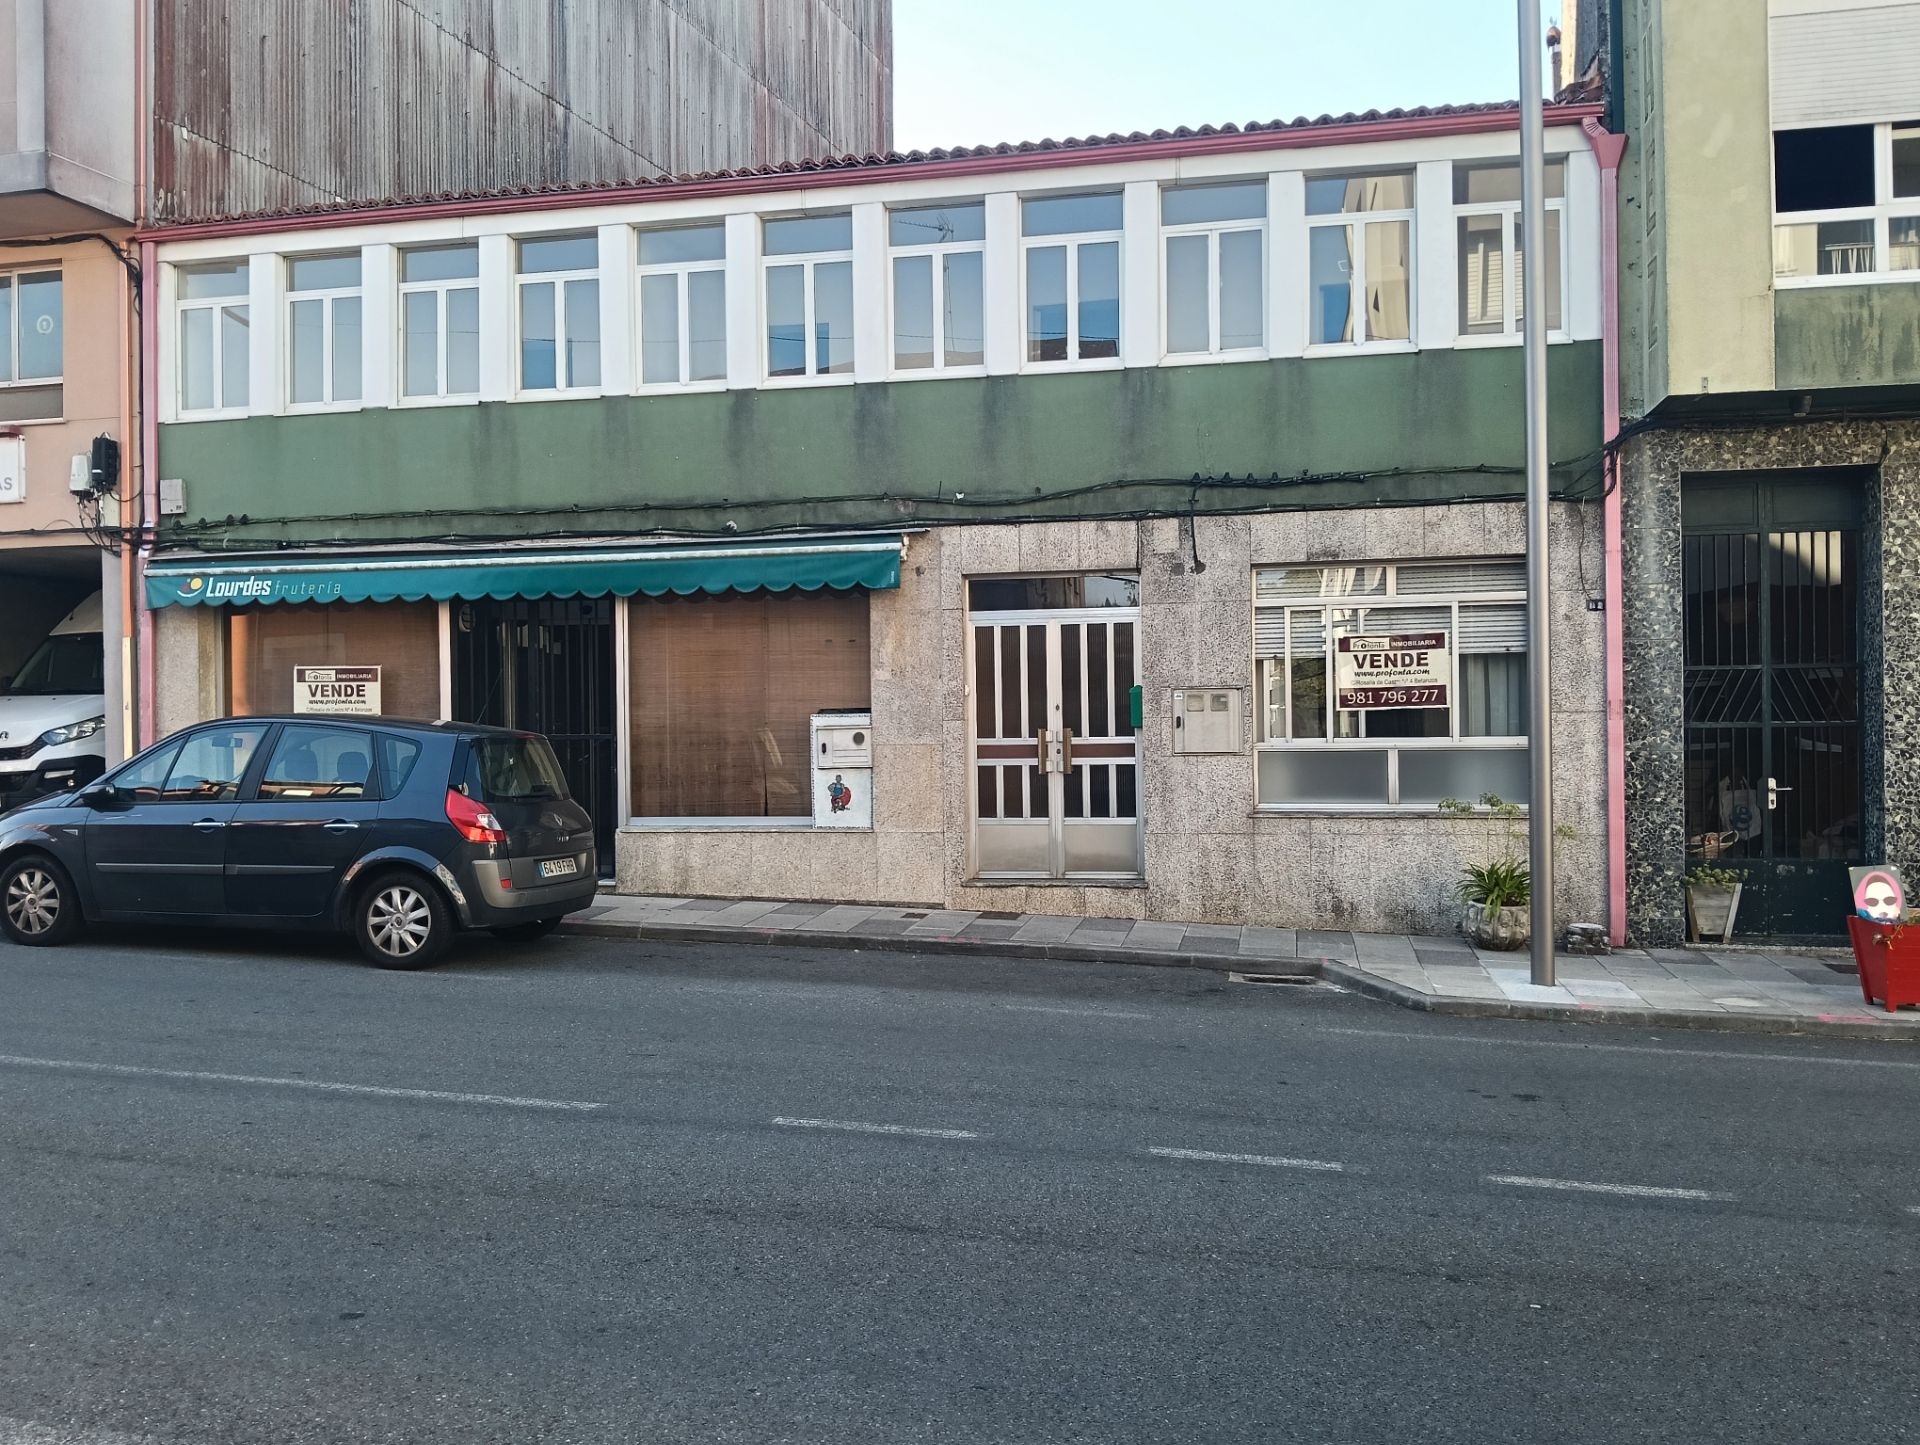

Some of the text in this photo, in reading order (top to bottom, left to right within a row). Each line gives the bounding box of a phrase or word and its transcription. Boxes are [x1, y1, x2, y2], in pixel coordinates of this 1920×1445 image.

[206, 575, 342, 598] Lourdes frutería
[1353, 652, 1429, 669] VENDE
[1354, 669, 1430, 677] www.profonta.com
[308, 684, 366, 697] VENDE
[1347, 689, 1439, 704] 981 796 277
[543, 861, 562, 874] 6419
